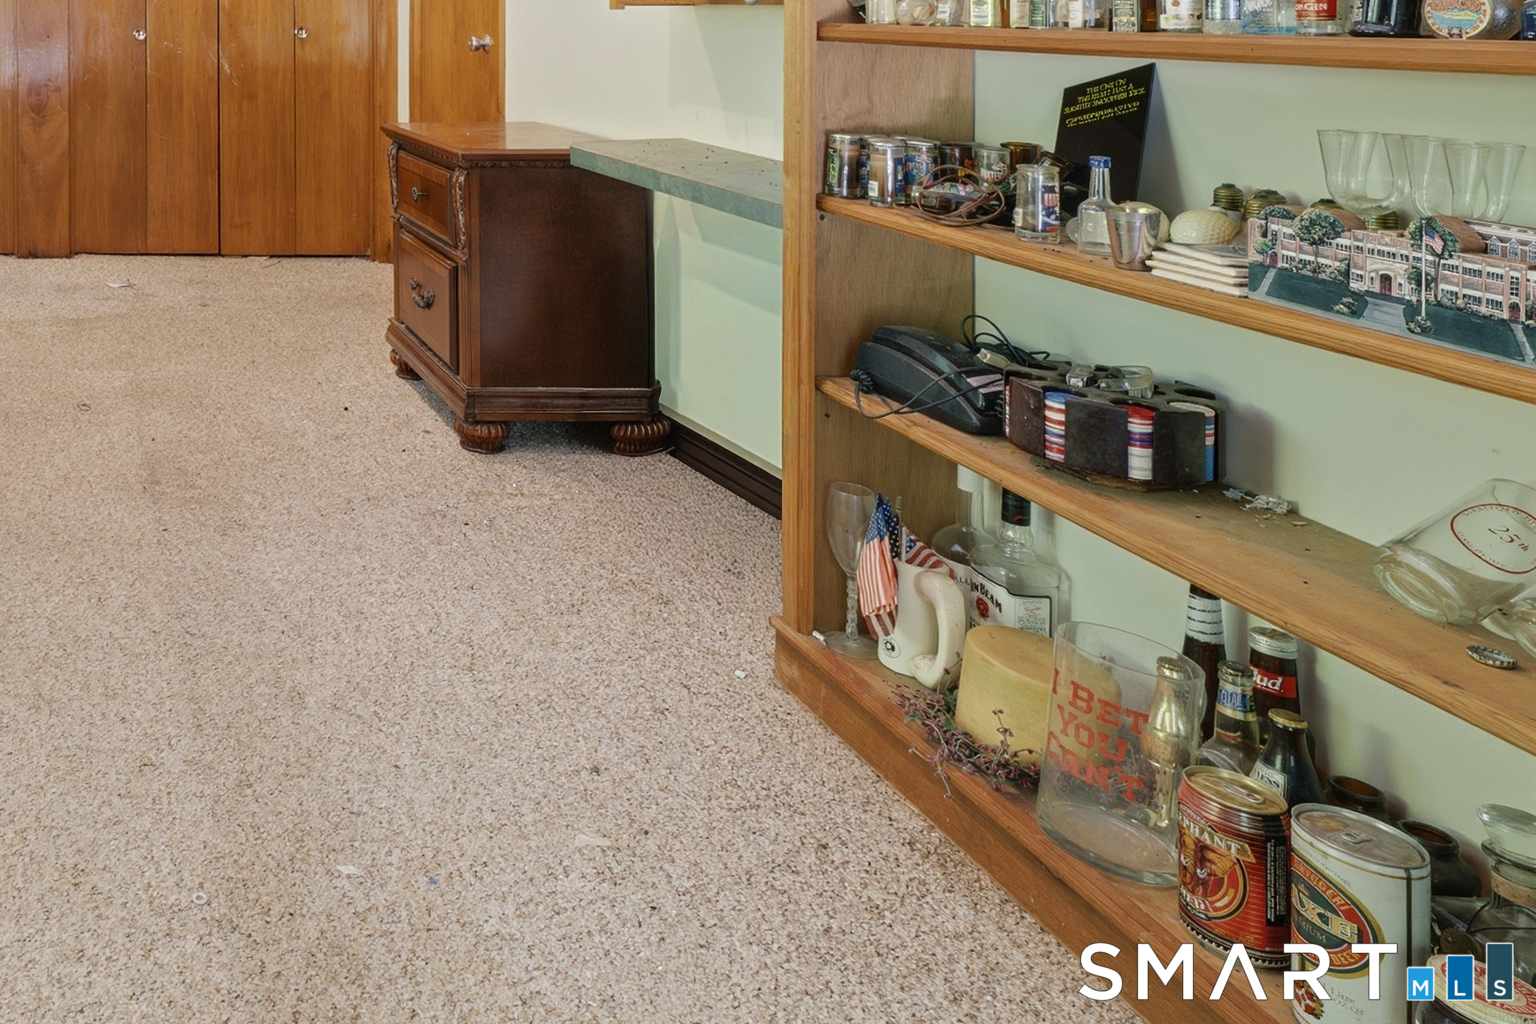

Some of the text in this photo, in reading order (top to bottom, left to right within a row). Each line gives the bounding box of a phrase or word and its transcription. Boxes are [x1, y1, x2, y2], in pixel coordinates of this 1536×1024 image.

[979, 582, 1002, 613] BEAM
[1052, 668, 1150, 735] I BET
[1057, 703, 1128, 762] YOU
[1046, 731, 1144, 802] CAN'T
